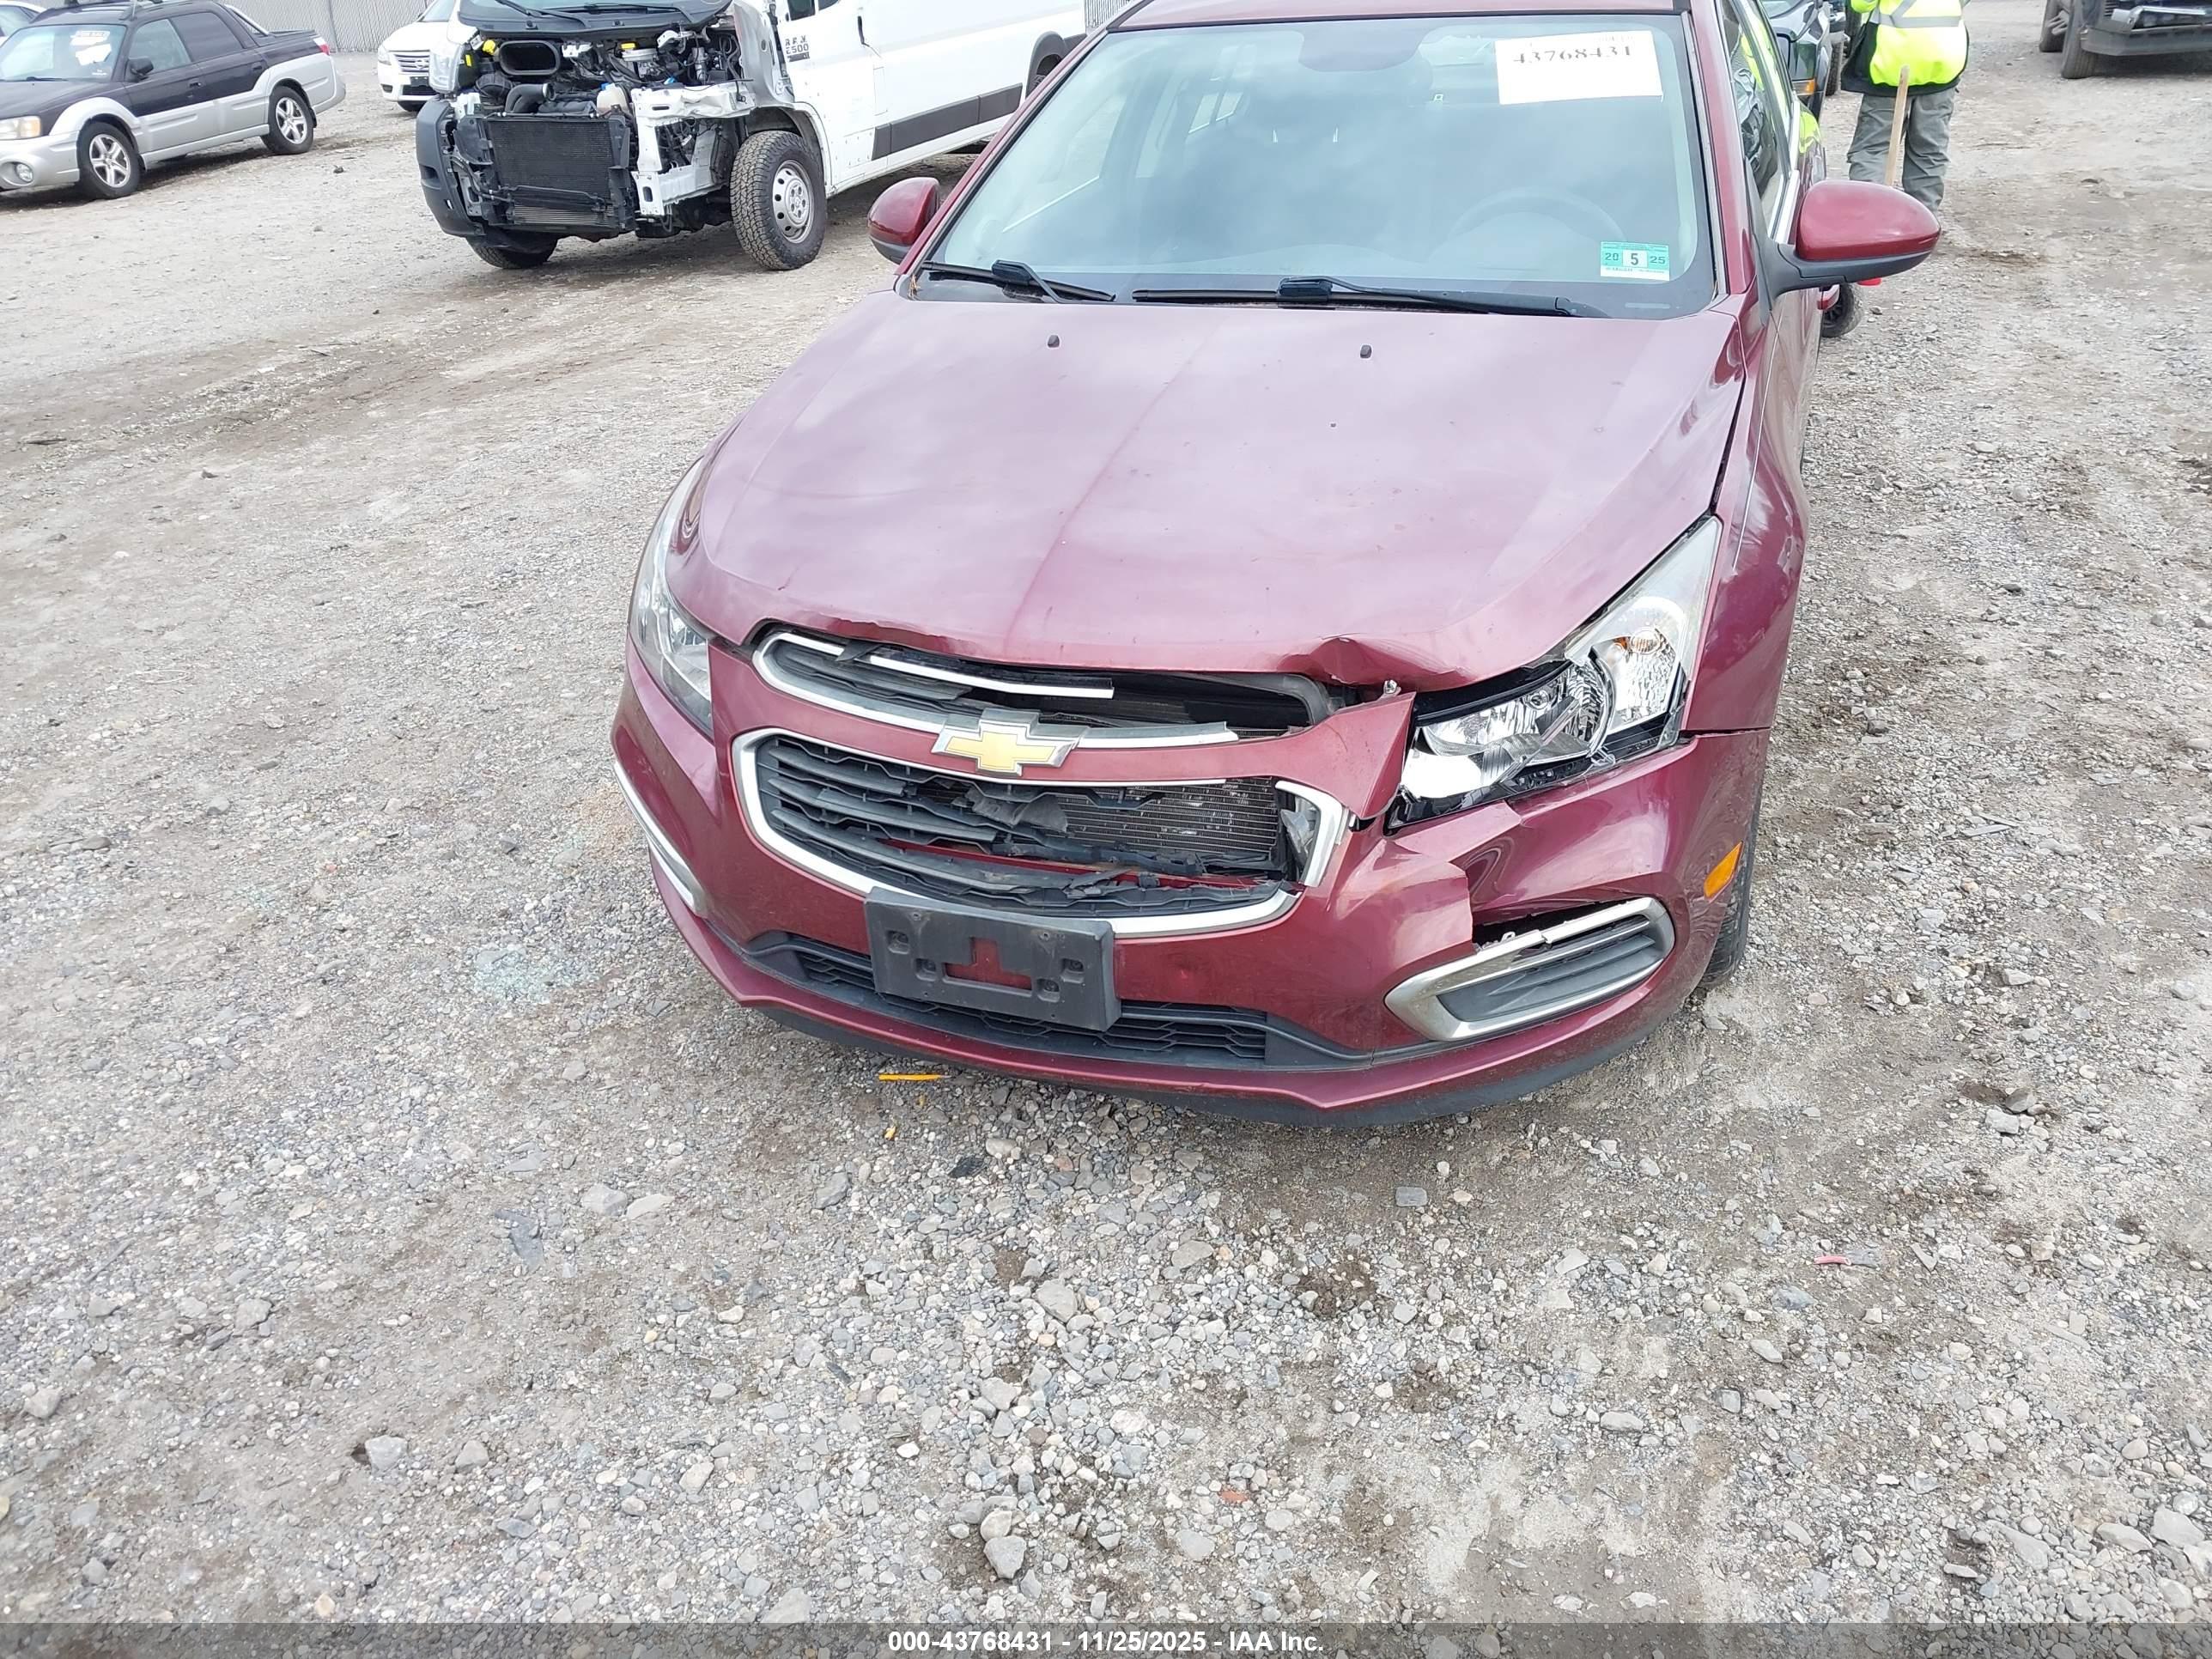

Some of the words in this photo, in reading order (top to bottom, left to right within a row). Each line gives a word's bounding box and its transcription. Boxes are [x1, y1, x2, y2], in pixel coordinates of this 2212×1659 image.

[1513, 46, 1631, 64] 43768431
[1605, 252, 1620, 261] 20
[1630, 252, 1639, 265] 5
[1650, 255, 1666, 264] 25
